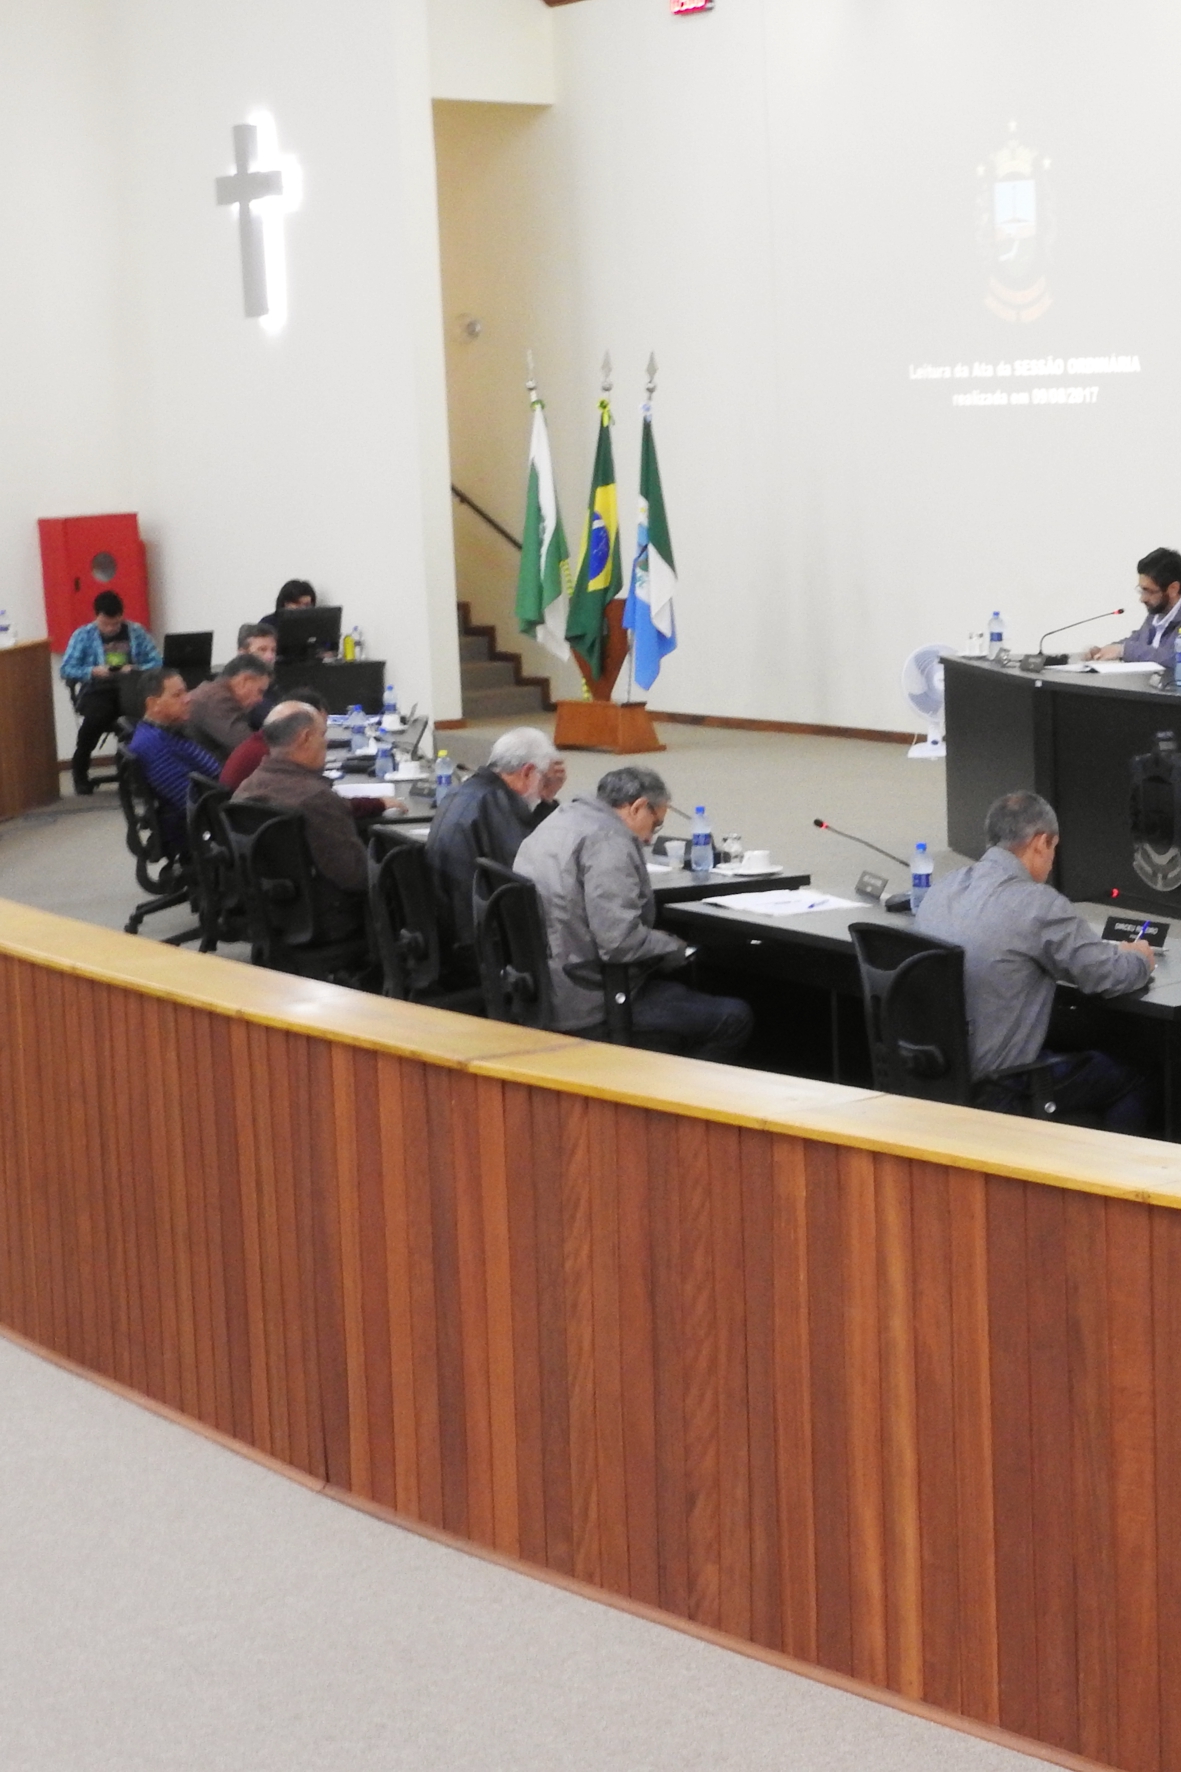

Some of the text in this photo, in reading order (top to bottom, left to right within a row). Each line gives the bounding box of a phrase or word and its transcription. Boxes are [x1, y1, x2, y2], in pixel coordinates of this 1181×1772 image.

[908, 362, 952, 380] Leitura
[972, 361, 994, 378] Ata
[1013, 355, 1065, 376] SESSÃO
[1067, 353, 1142, 375] ORDINÁRIA
[952, 389, 1008, 407] realizada
[1010, 391, 1030, 405] em
